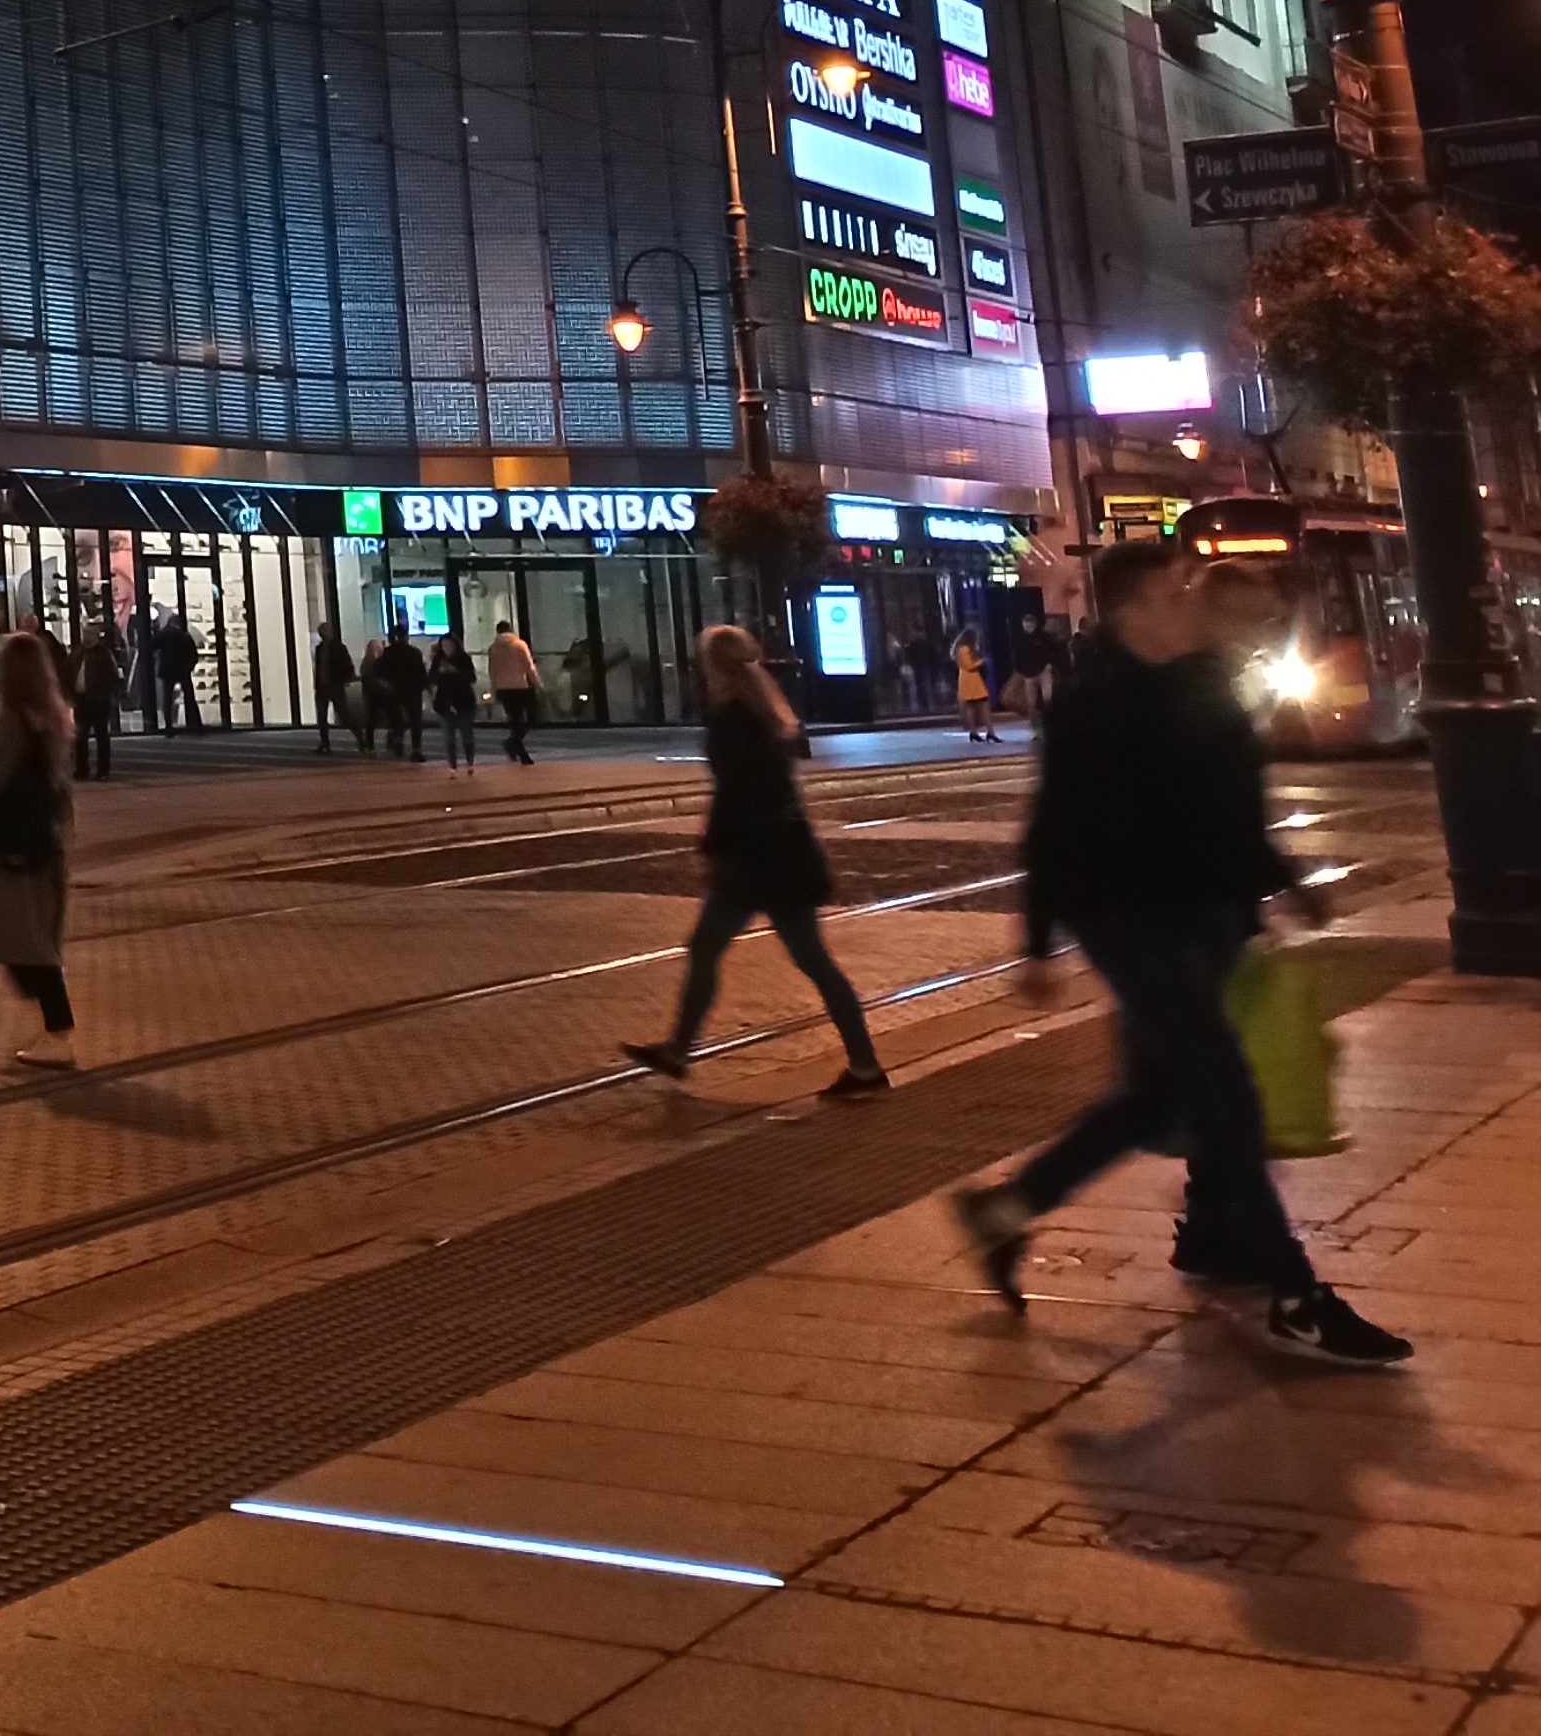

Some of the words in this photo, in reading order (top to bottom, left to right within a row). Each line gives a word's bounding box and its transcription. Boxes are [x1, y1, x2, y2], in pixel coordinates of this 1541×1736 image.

[853, 17, 917, 82] Bershka
[958, 64, 991, 109] hebe
[1194, 154, 1233, 178] Plac
[1238, 146, 1326, 175] Wilhelma
[1445, 138, 1540, 166] Stawowa
[1220, 181, 1319, 210] Szewczyka
[810, 268, 877, 322] CROPP
[402, 494, 499, 532] BNP
[508, 493, 697, 532] PARIBAS
